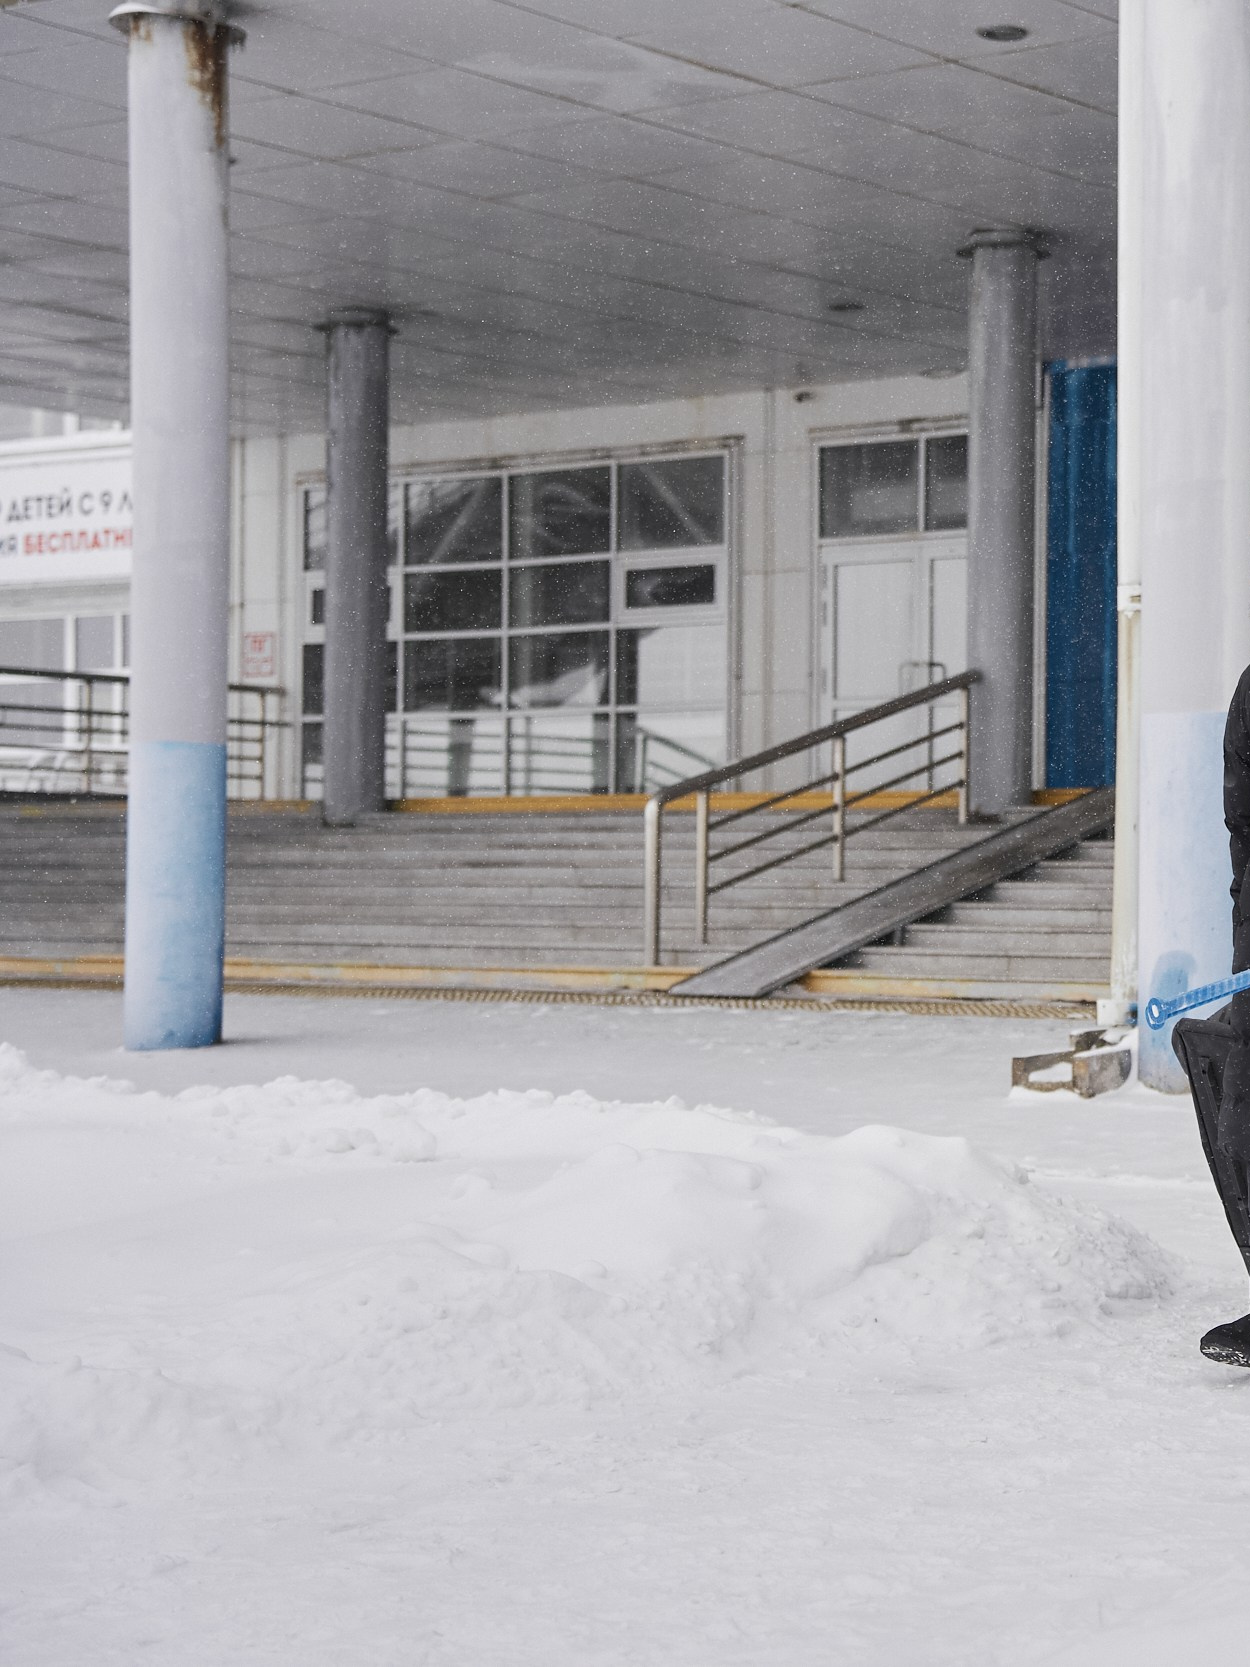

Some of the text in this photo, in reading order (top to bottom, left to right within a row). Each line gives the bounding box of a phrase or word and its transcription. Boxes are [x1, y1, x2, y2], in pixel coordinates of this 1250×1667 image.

[7, 486, 73, 522] ДЕТЕЙ
[79, 490, 94, 516] С
[100, 489, 112, 514] 9
